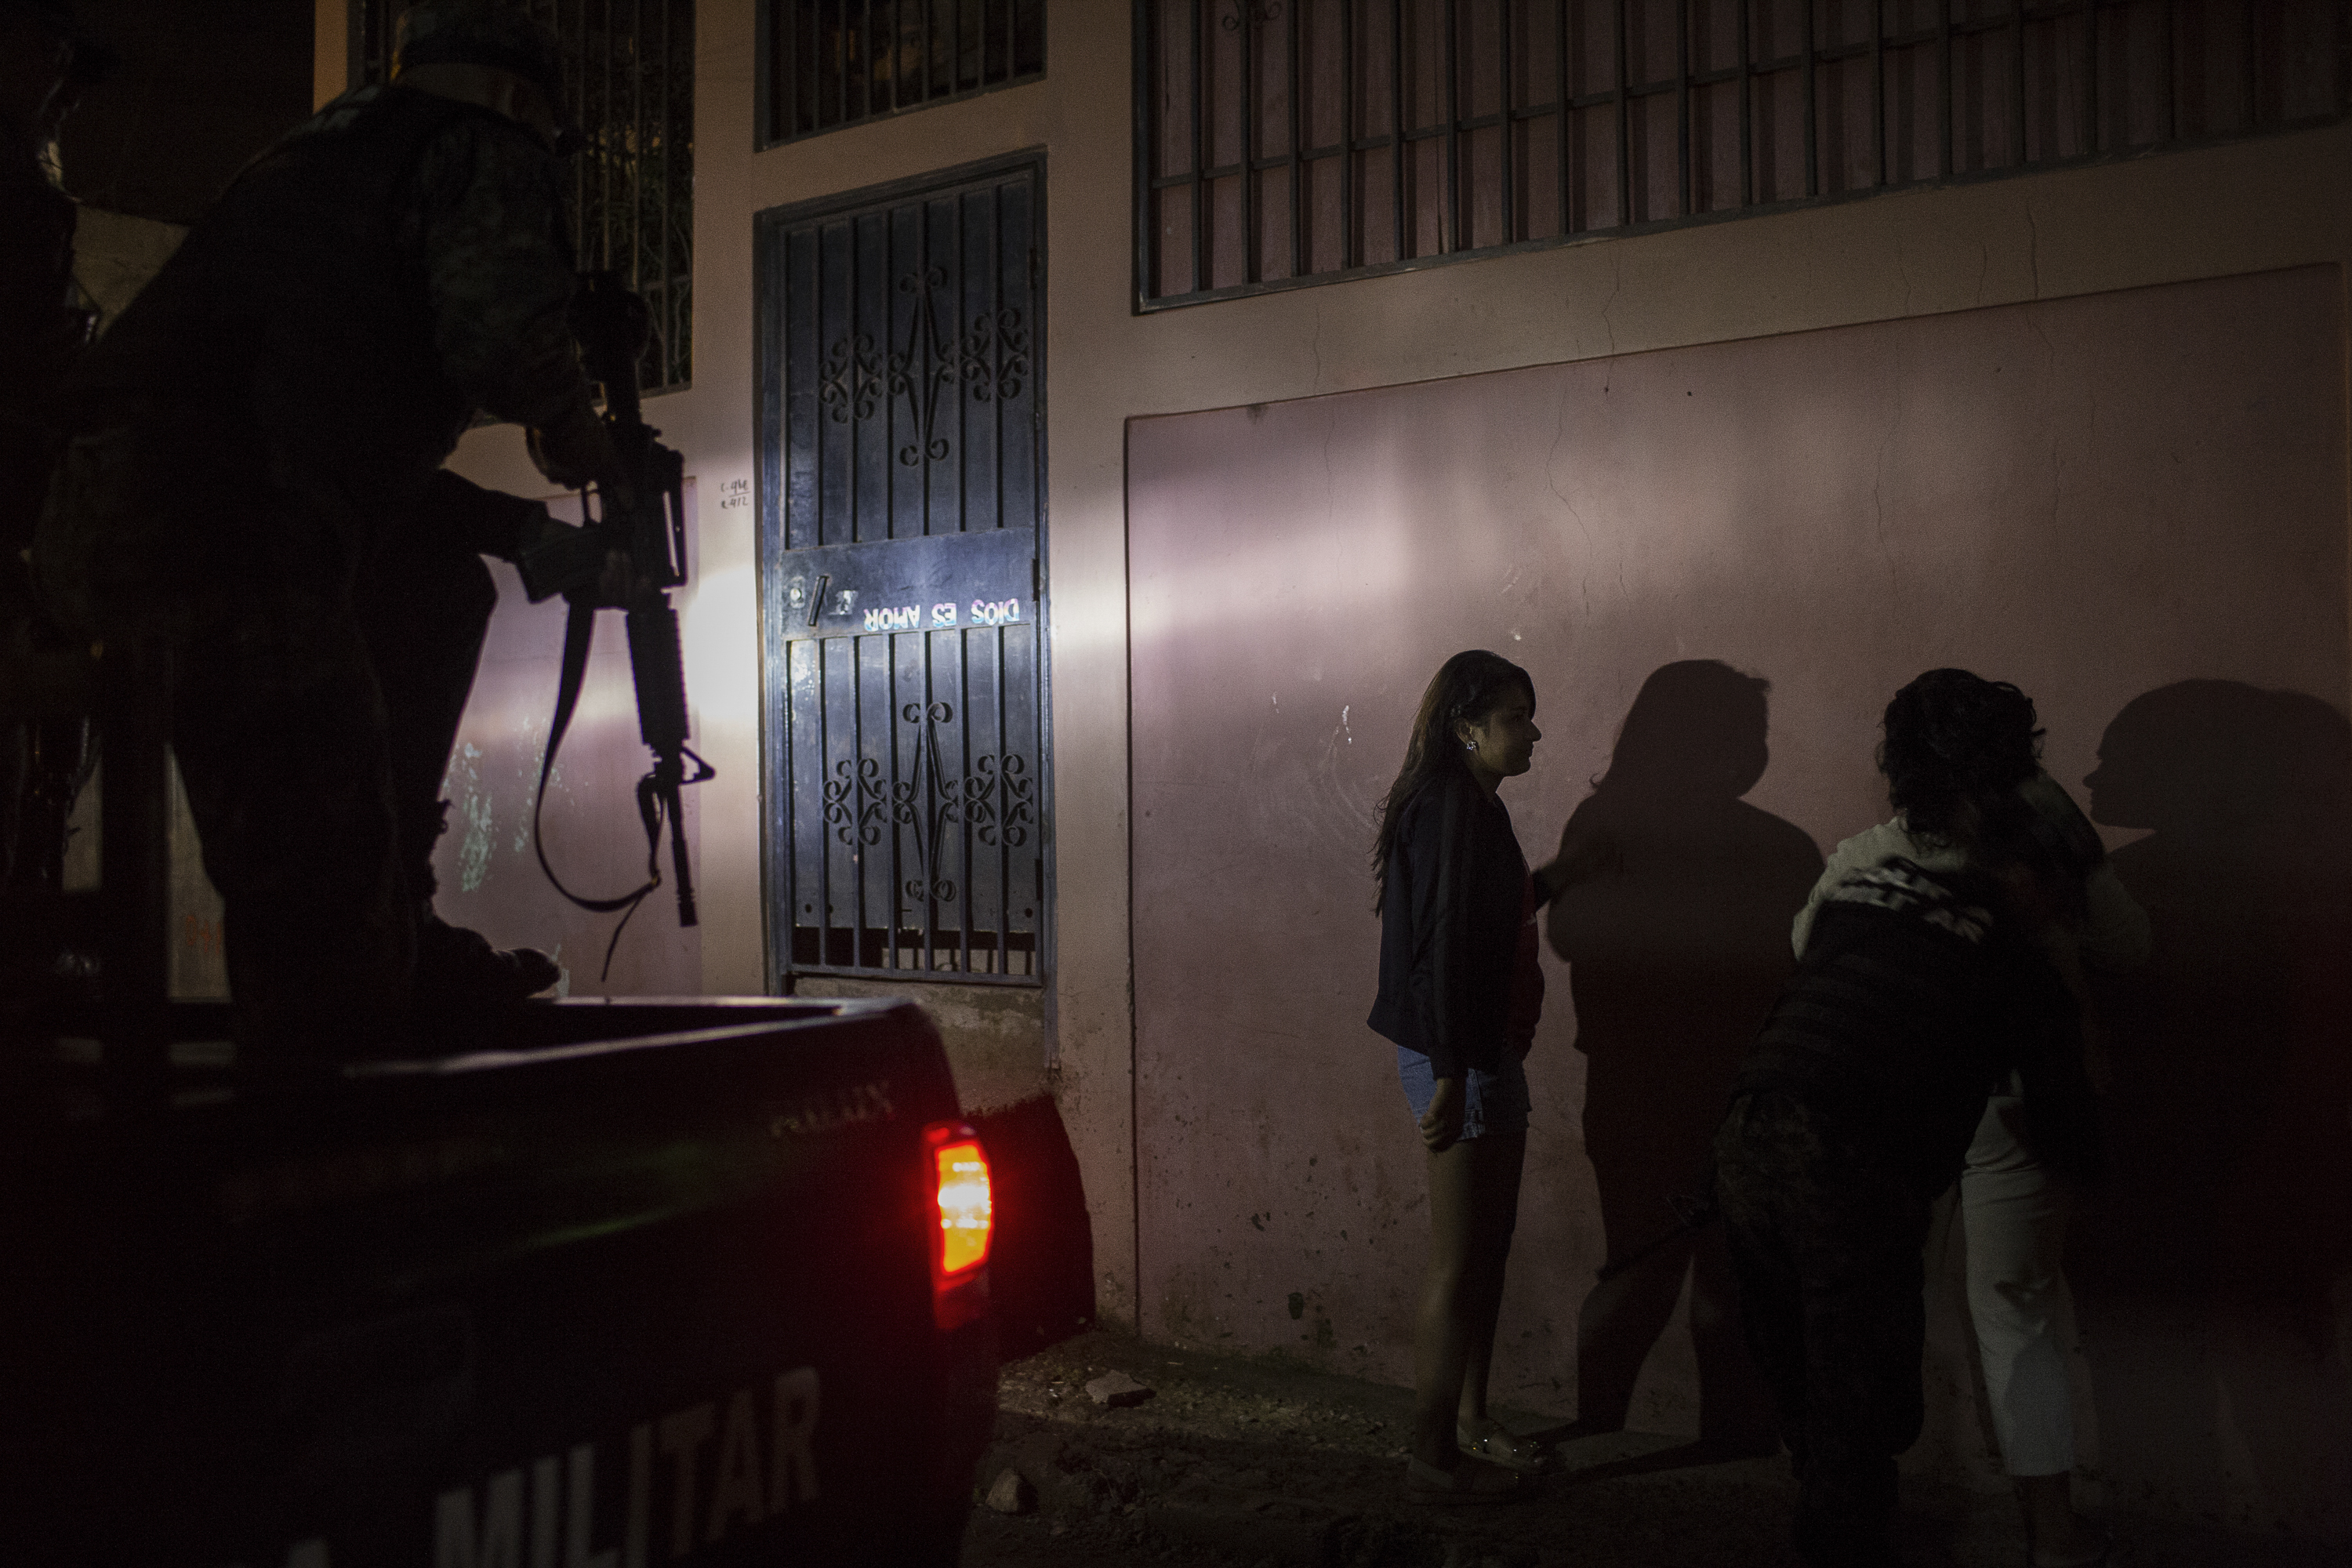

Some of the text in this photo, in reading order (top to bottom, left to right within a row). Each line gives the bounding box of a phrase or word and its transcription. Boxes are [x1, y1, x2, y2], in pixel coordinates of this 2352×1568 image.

[864, 598, 1020, 632] DIOS ES AMOR
